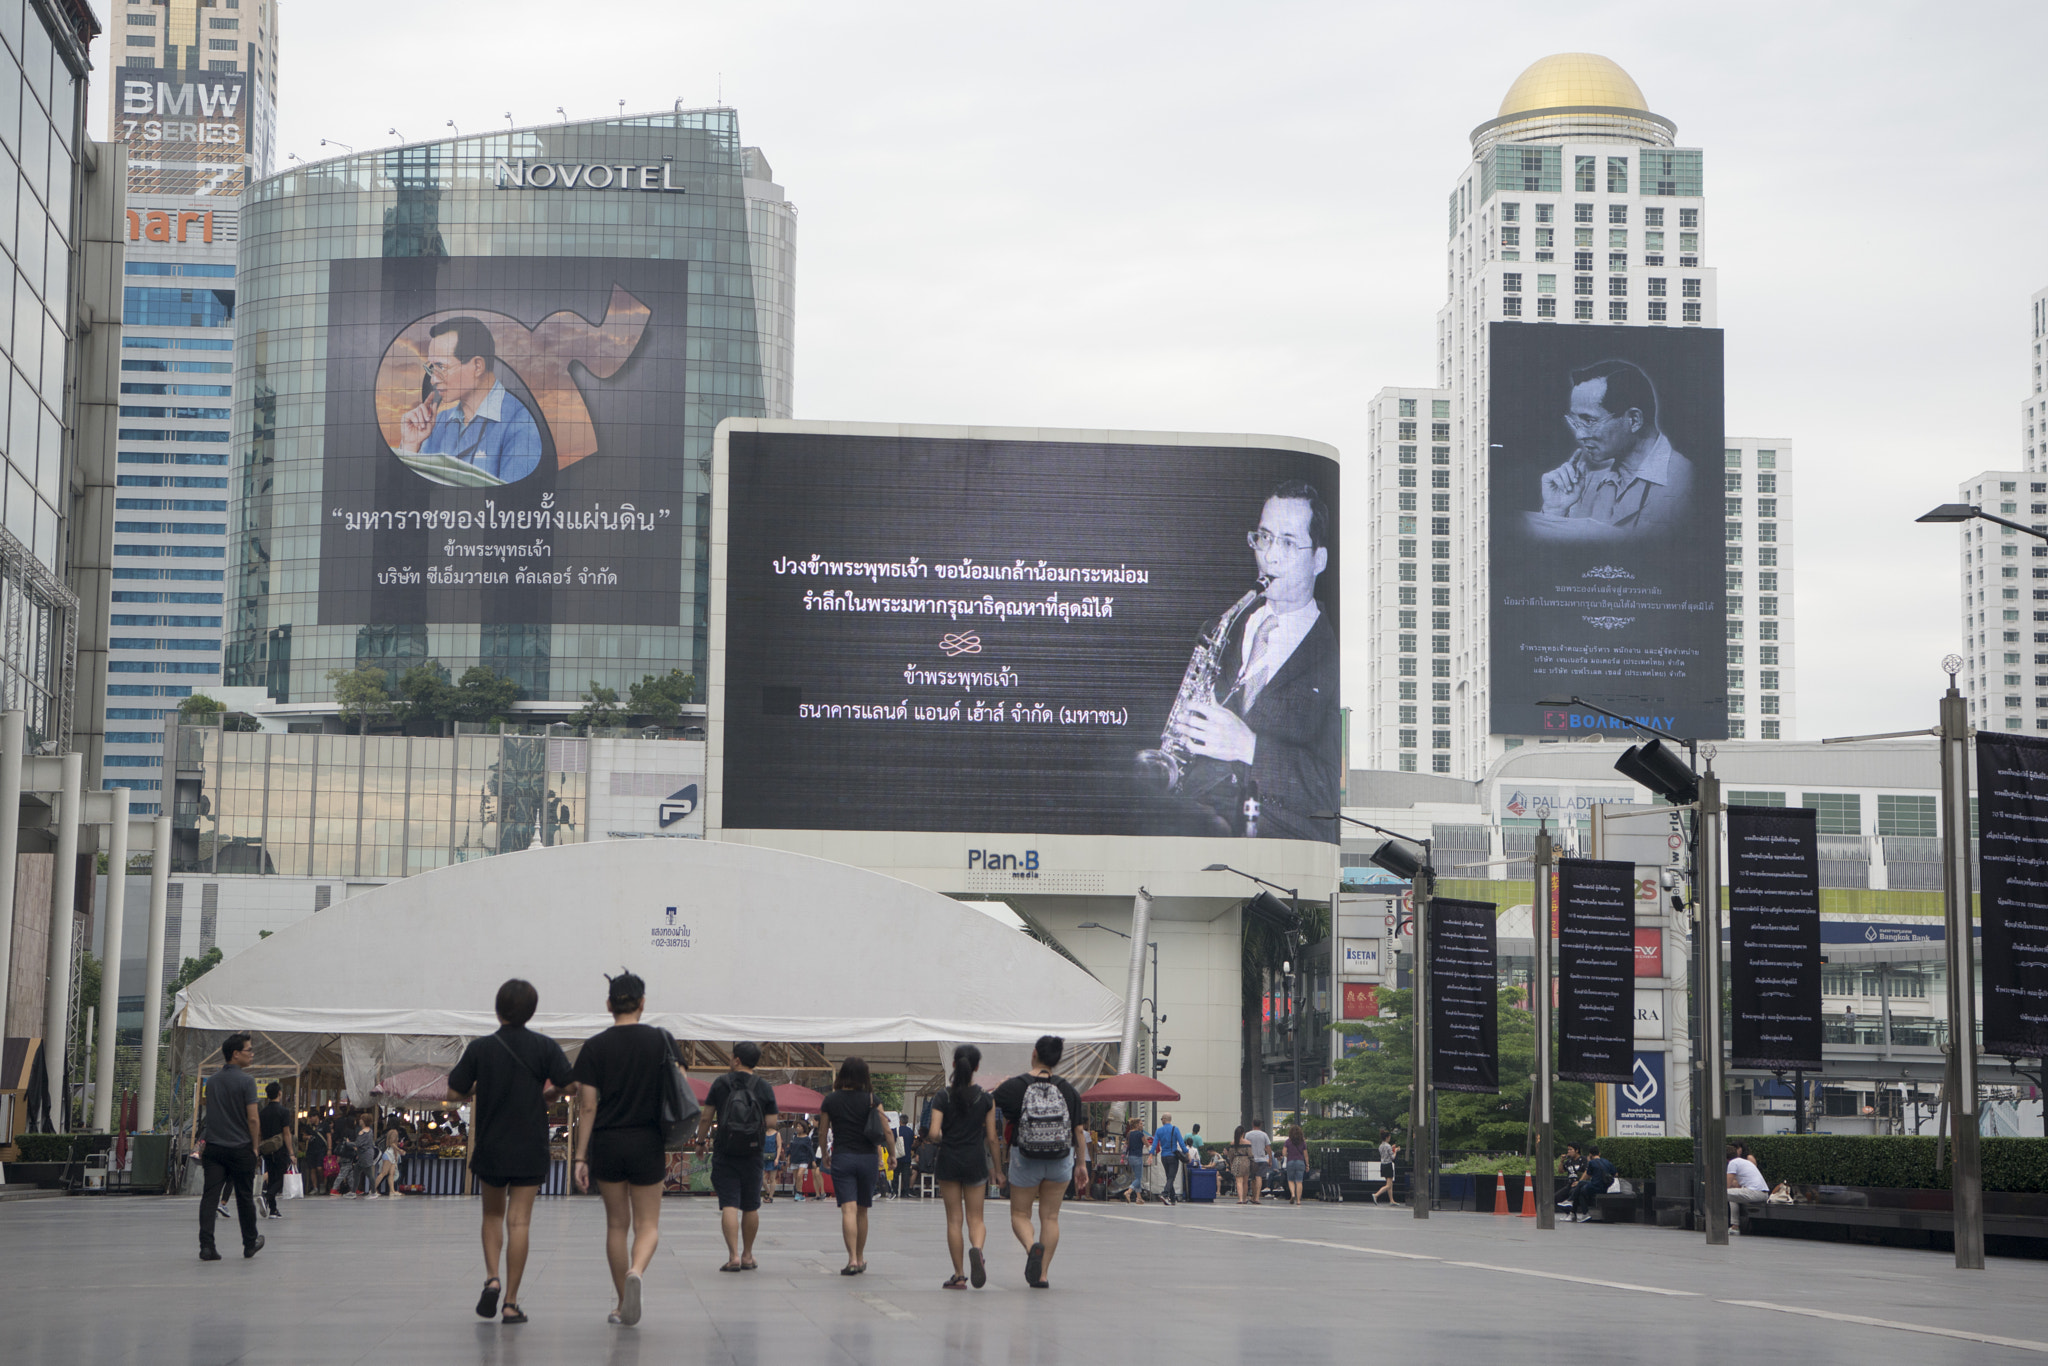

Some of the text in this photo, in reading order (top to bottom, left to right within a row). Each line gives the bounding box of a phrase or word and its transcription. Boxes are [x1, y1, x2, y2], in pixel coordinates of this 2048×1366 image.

[124, 80, 242, 118] BMW
[123, 120, 240, 144] 7 SERIES
[495, 157, 685, 193] NOVOTEL
[331, 492, 671, 532] “มหาราชของไทยทั้งแผ่นดิน”
[444, 539, 550, 562] ข้าพระพุทธเจ้า
[378, 565, 617, 584] บริษัท ซีเอ็มวายเค คัลเลอร์ จำกัด
[773, 554, 1148, 583] ปวงข้าพระพุทธเจ้า ขอน้อมเกล้าน้อมกระหม่อม
[804, 590, 1113, 623] รำลึกในพระมหากรุณาธิคุณหาที่สุดมิได้
[904, 664, 1017, 692] ข้าพระพุทธเจ้า
[800, 699, 1127, 725] ธนาคารแลนด์ แอนด์ เฮ้าส์ จำกัด (มหาชน)
[1012, 871, 1039, 879] media
